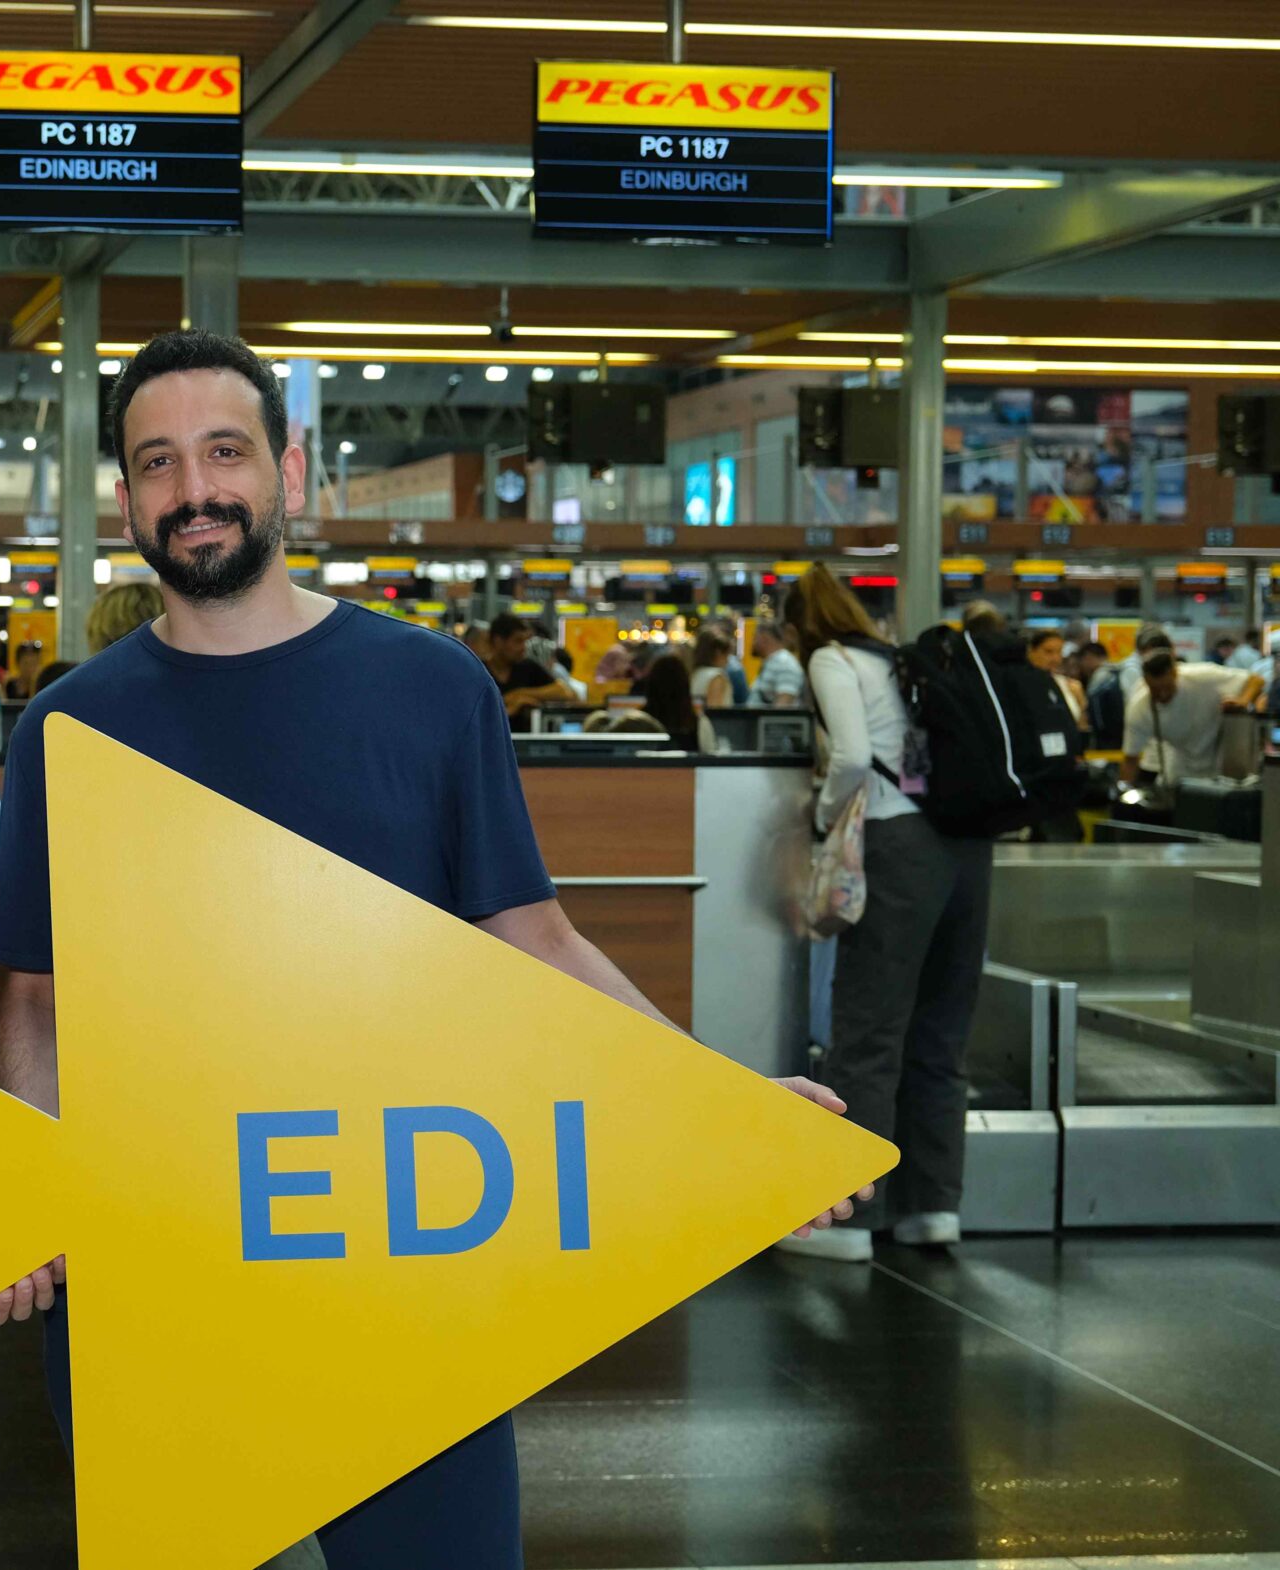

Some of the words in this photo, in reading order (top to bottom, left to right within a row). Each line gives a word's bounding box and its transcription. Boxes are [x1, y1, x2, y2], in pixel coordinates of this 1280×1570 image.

[545, 78, 826, 115] PEGASUS
[41, 122, 76, 145] PC
[82, 123, 137, 146] 1187
[640, 136, 673, 158] PC
[679, 137, 729, 159] 1187
[20, 158, 157, 181] EDINBURGH
[620, 169, 748, 192] EDINBURGH
[237, 1100, 590, 1261] EDI
